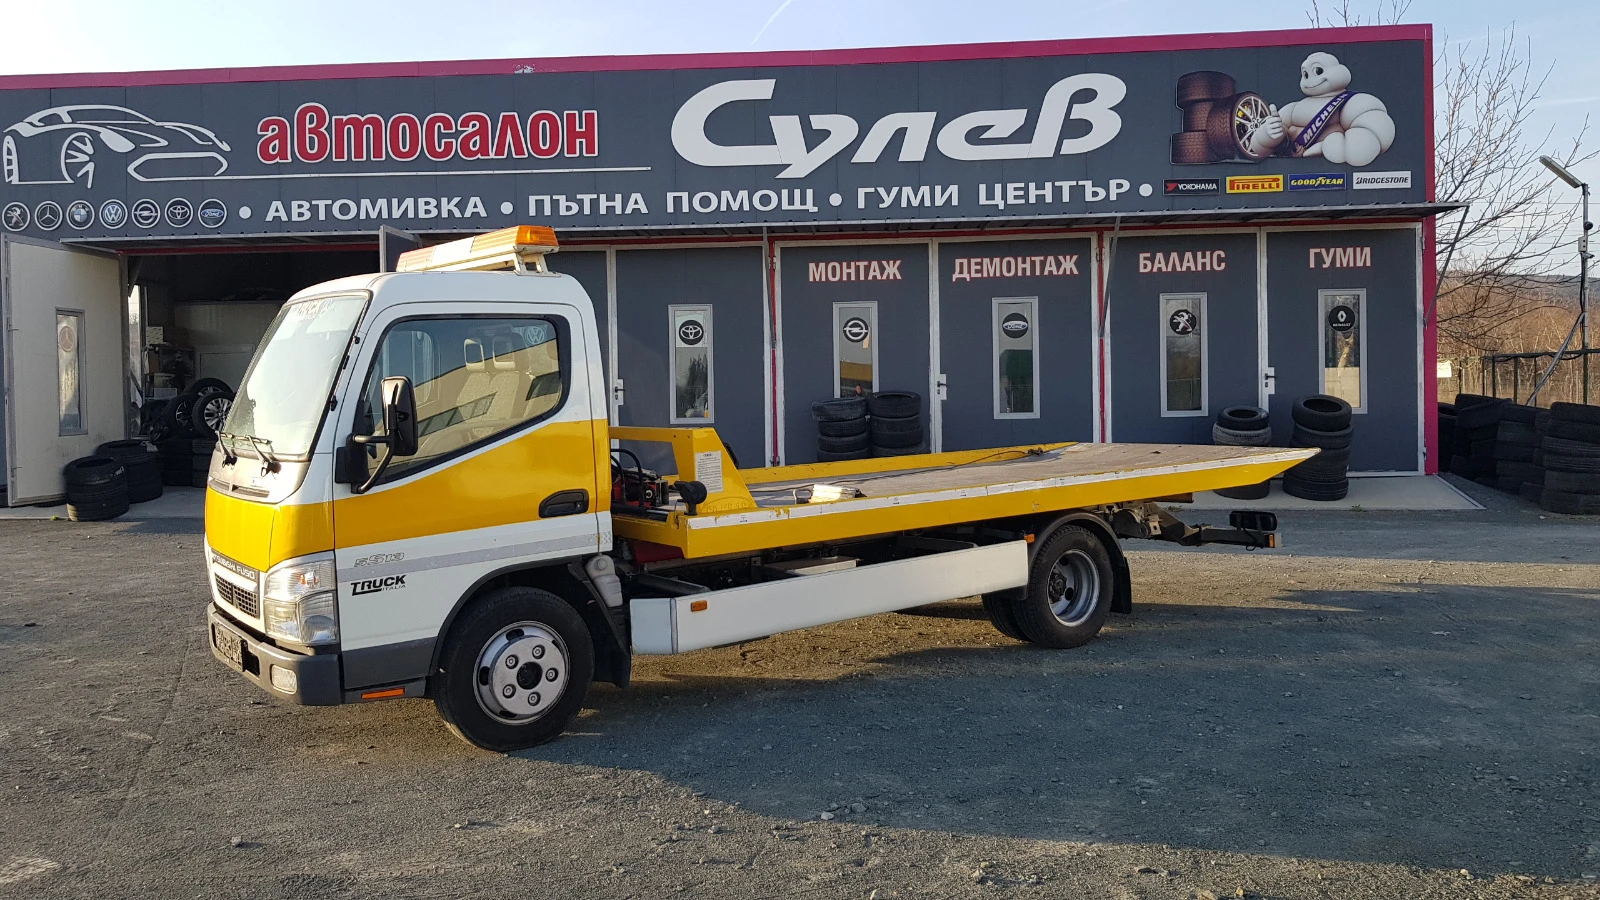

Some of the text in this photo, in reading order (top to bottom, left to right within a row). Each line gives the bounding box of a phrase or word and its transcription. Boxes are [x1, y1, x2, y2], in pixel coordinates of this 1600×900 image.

[671, 72, 1127, 178] Сулев
[1303, 94, 1349, 143] MICHELIN
[257, 103, 598, 164] автосалон
[1178, 183, 1217, 191] YOKOHAMA
[1229, 178, 1280, 191] PIRELLI
[1291, 177, 1344, 187] GOODYEAR
[1355, 177, 1409, 185] BRIDGESTONE
[265, 178, 1130, 222] АВТОМИВКА ПЪТНА ПОМОЩ ГУМИ ЦЕНТЪР
[952, 254, 1080, 282] ДЕМОНТАЖ
[1138, 249, 1227, 273] БАЛАНС
[1308, 246, 1372, 269] ГУМИ
[808, 259, 903, 282] МОНТАЖ
[236, 566, 256, 580] FUSO
[351, 575, 406, 596] TRUCK
